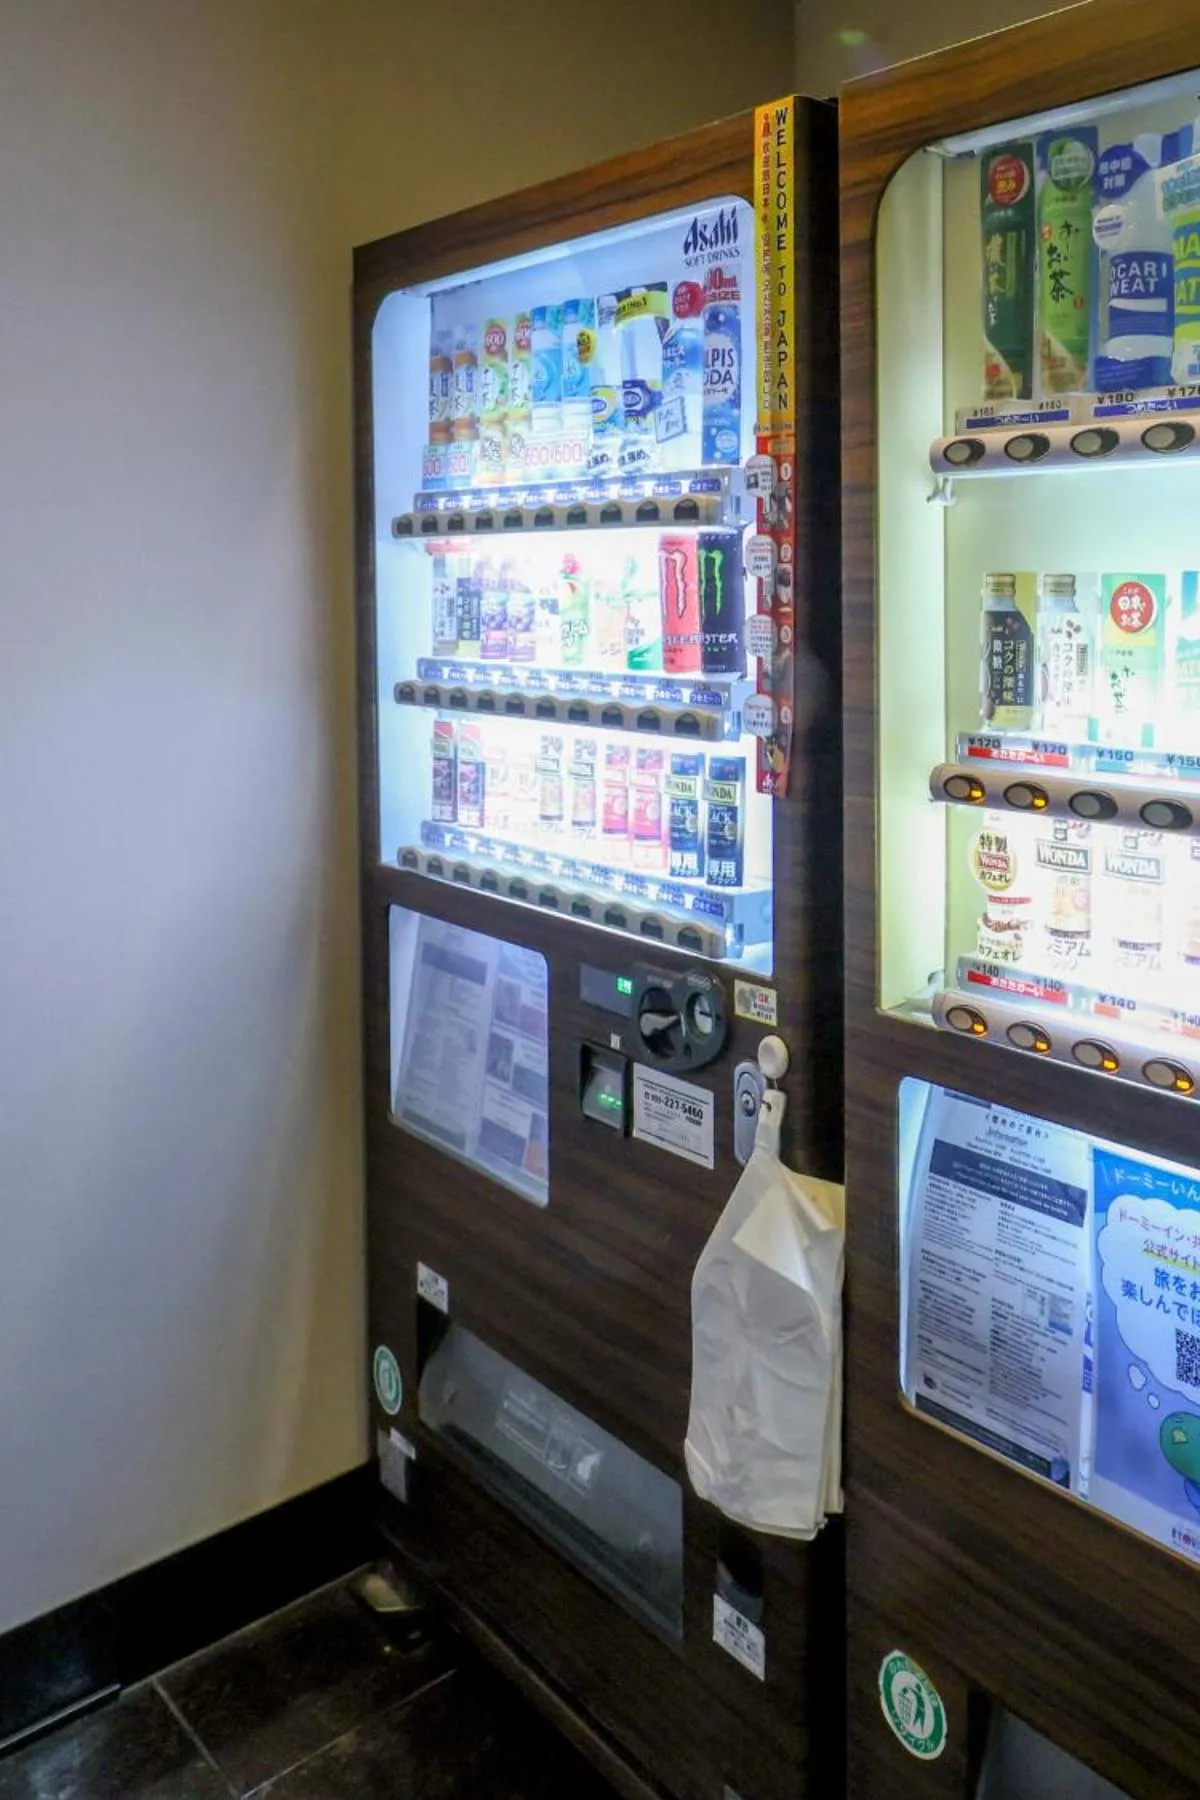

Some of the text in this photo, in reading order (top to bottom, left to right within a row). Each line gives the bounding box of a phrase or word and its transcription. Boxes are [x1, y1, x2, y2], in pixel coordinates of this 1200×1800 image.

[683, 205, 739, 255] Asahi
[775, 107, 789, 411] WELCOME TO JAPAN
[979, 834, 1009, 853] 特製
[1037, 846, 1089, 869] WONDA
[1105, 856, 1161, 878] WONDA
